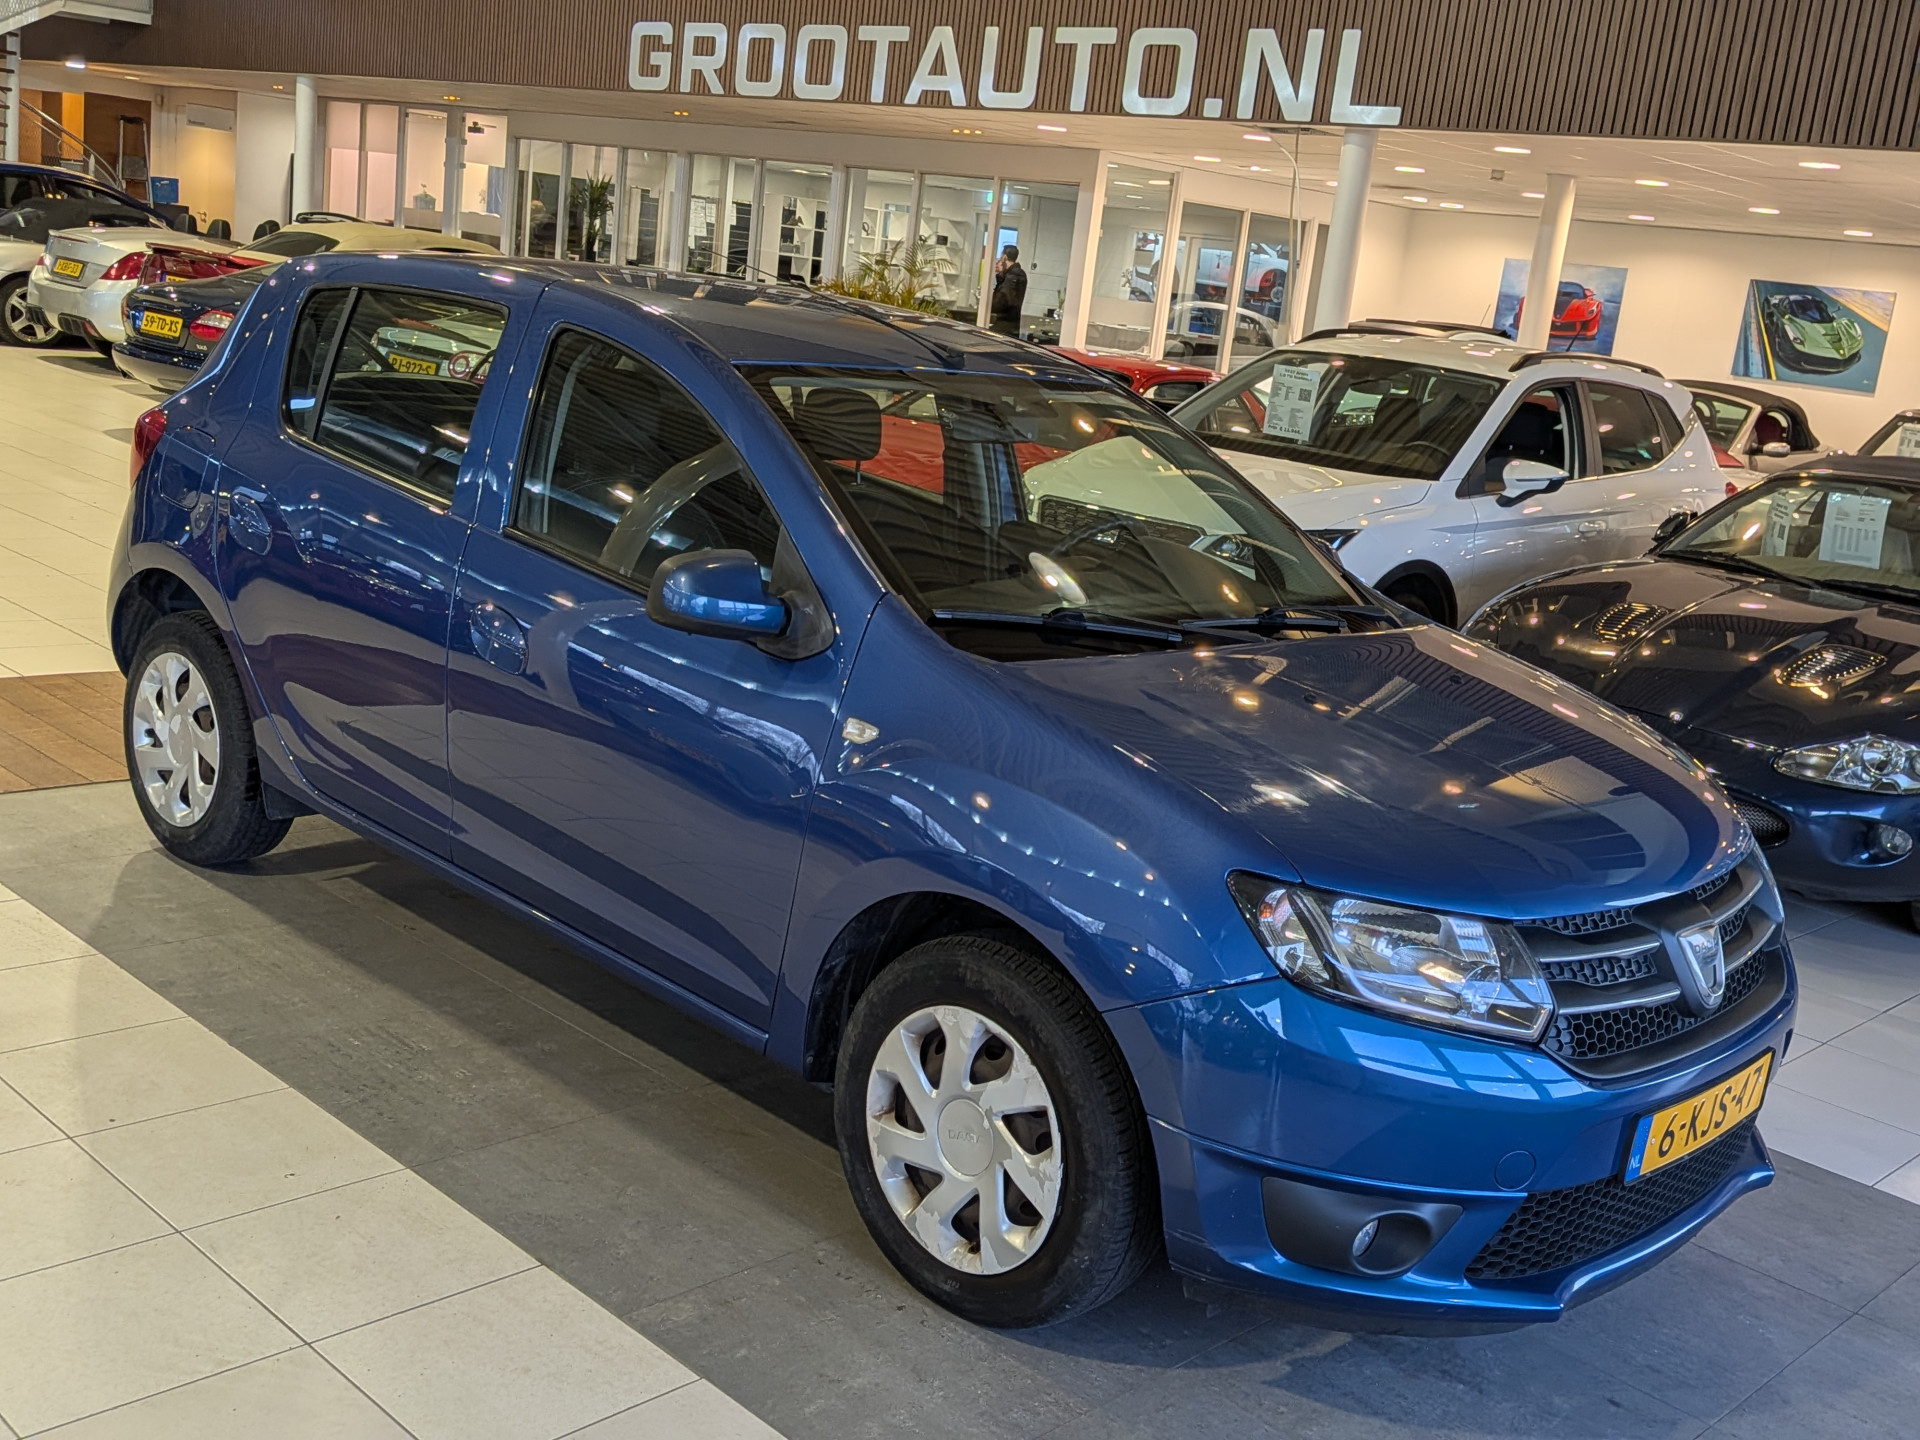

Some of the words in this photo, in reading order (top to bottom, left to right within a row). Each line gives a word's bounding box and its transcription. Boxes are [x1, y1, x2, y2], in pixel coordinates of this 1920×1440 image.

[627, 20, 1402, 127] GROOTAUTO.NL
[142, 314, 179, 335] 59-TD-XS
[1658, 1063, 1764, 1159] 6-KJS-47
[1629, 1153, 1641, 1171] NL
